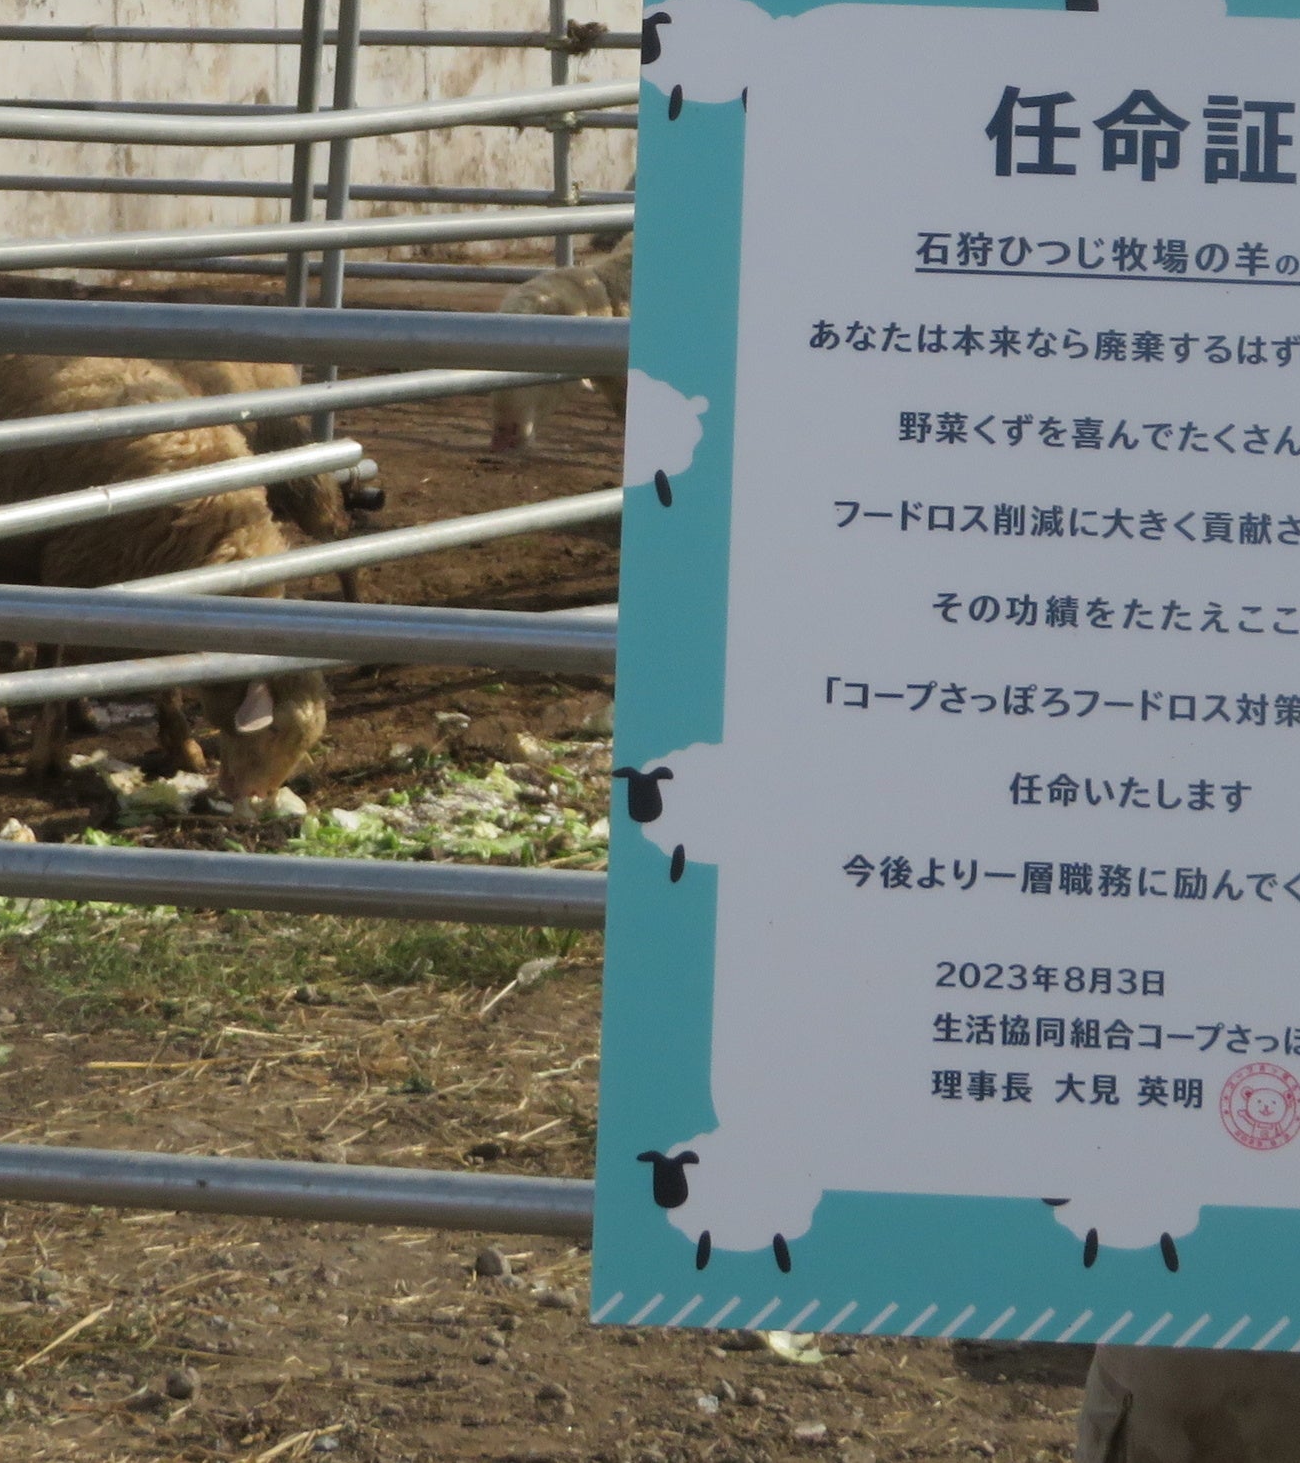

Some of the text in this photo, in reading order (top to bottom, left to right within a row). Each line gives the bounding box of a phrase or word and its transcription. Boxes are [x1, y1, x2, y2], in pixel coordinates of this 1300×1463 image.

[984, 84, 1297, 185] 任命証
[1009, 772, 1252, 813] 任命いたします
[935, 961, 1166, 997] 2023年8月3日
[931, 1069, 1033, 1103] 理事長
